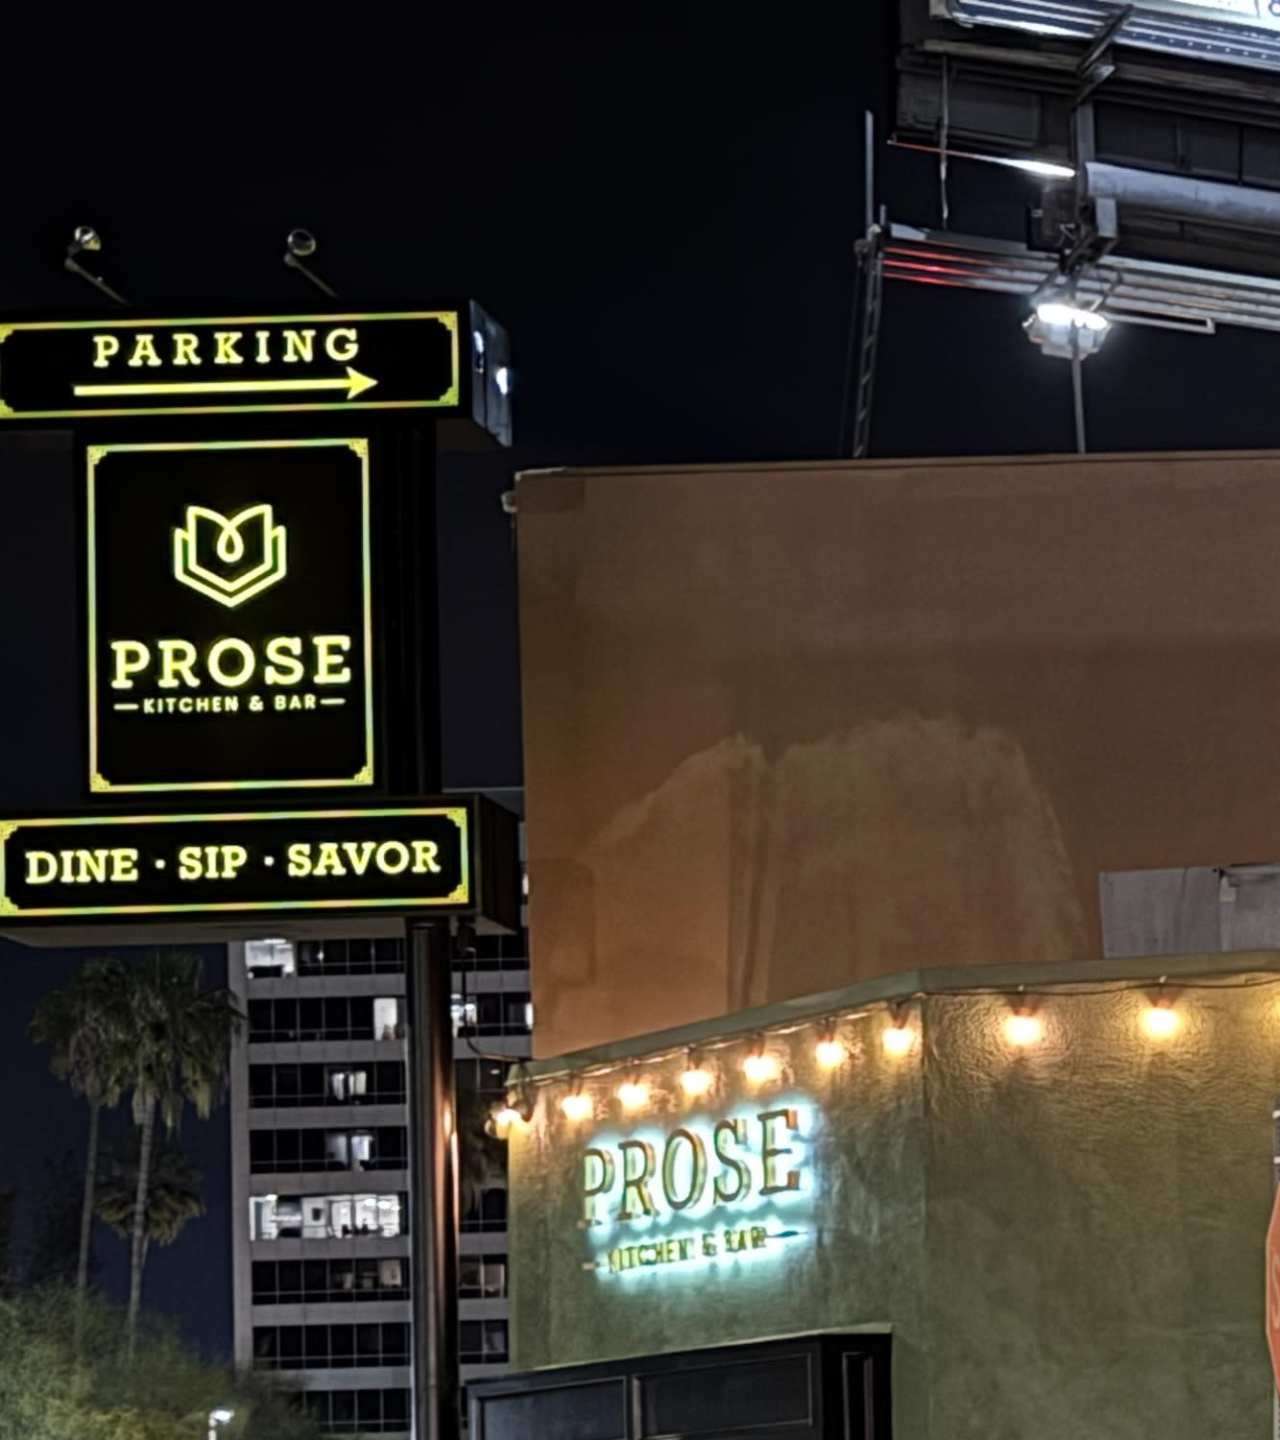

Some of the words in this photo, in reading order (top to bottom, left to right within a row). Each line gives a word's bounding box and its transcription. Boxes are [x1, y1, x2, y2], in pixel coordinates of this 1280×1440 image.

[92, 327, 360, 368] PARKING
[111, 635, 351, 689] PROSE
[144, 696, 238, 713] KITCHEN
[249, 695, 263, 711] &
[275, 694, 316, 710] BAR
[25, 848, 138, 884] DINE
[179, 845, 247, 880] SIP
[288, 841, 441, 876] SAVOR
[581, 1108, 801, 1226] PROSE
[606, 1235, 693, 1273] KITCHEN
[724, 1225, 768, 1254] BAR
